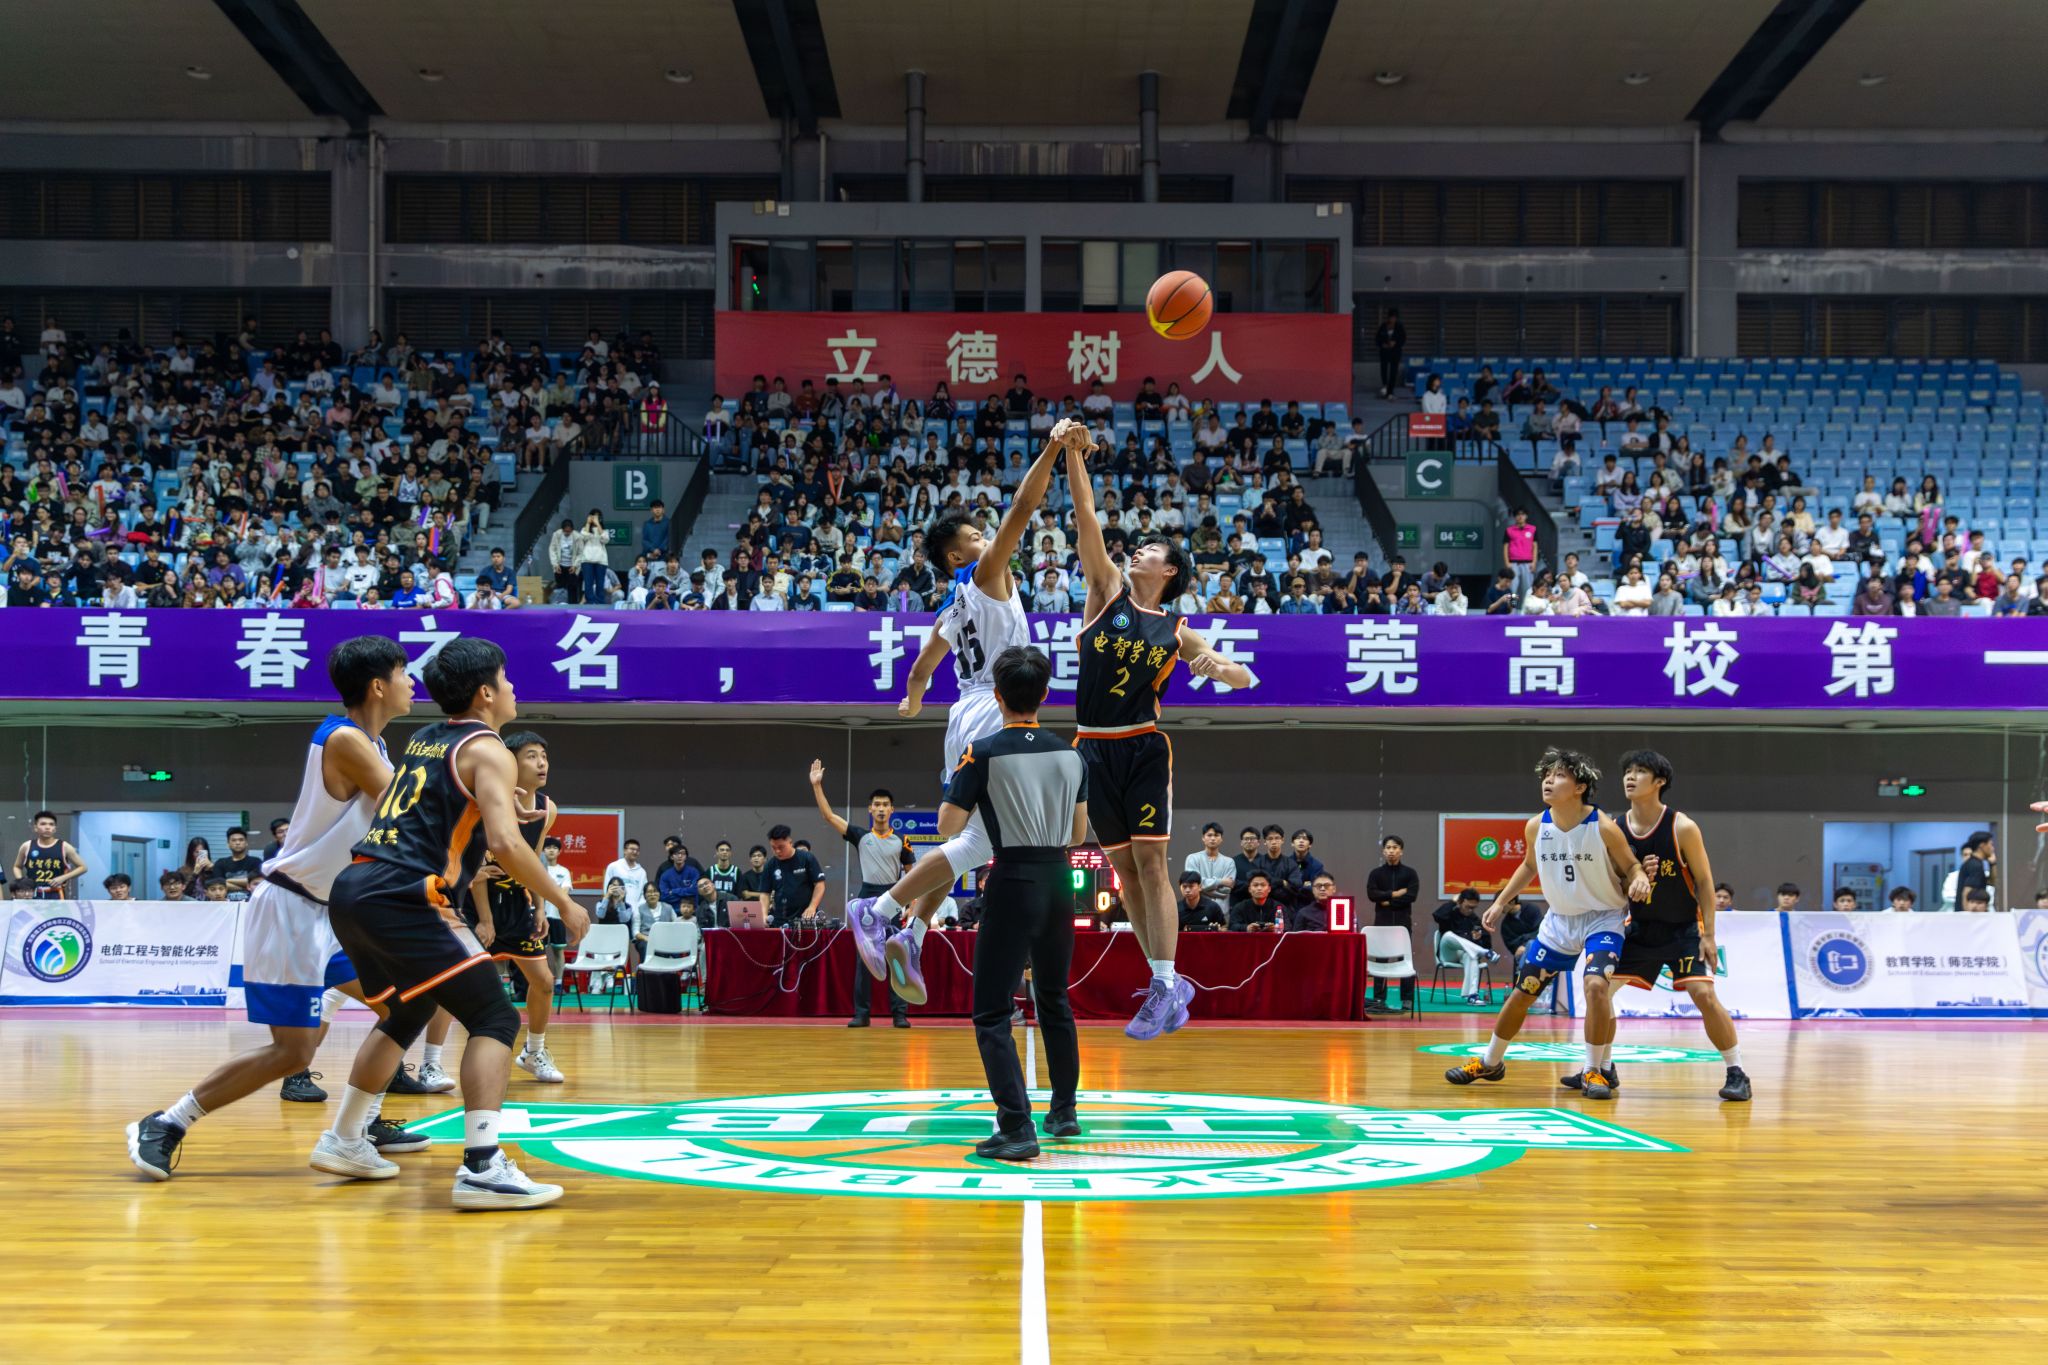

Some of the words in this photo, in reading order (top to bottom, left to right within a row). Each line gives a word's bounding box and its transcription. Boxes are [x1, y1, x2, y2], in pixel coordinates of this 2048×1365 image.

[825, 328, 1243, 385] 立德树人
[626, 470, 648, 500] B
[1416, 459, 1442, 489] C
[957, 618, 985, 680] 15
[1094, 631, 1167, 668] 电智学院
[1109, 667, 1130, 696] 2
[380, 764, 427, 819] 10
[1138, 803, 1156, 828] 2
[35, 870, 54, 882] 22
[1072, 869, 1084, 889] 0
[1564, 864, 1575, 882] 9
[1097, 891, 1110, 911] 0
[1330, 898, 1350, 931] 0
[101, 944, 219, 957] 电信工程与智能化学院
[1535, 949, 1547, 962] 9
[1678, 955, 1695, 974] 17
[639, 1149, 1422, 1190] BASKETBALL
